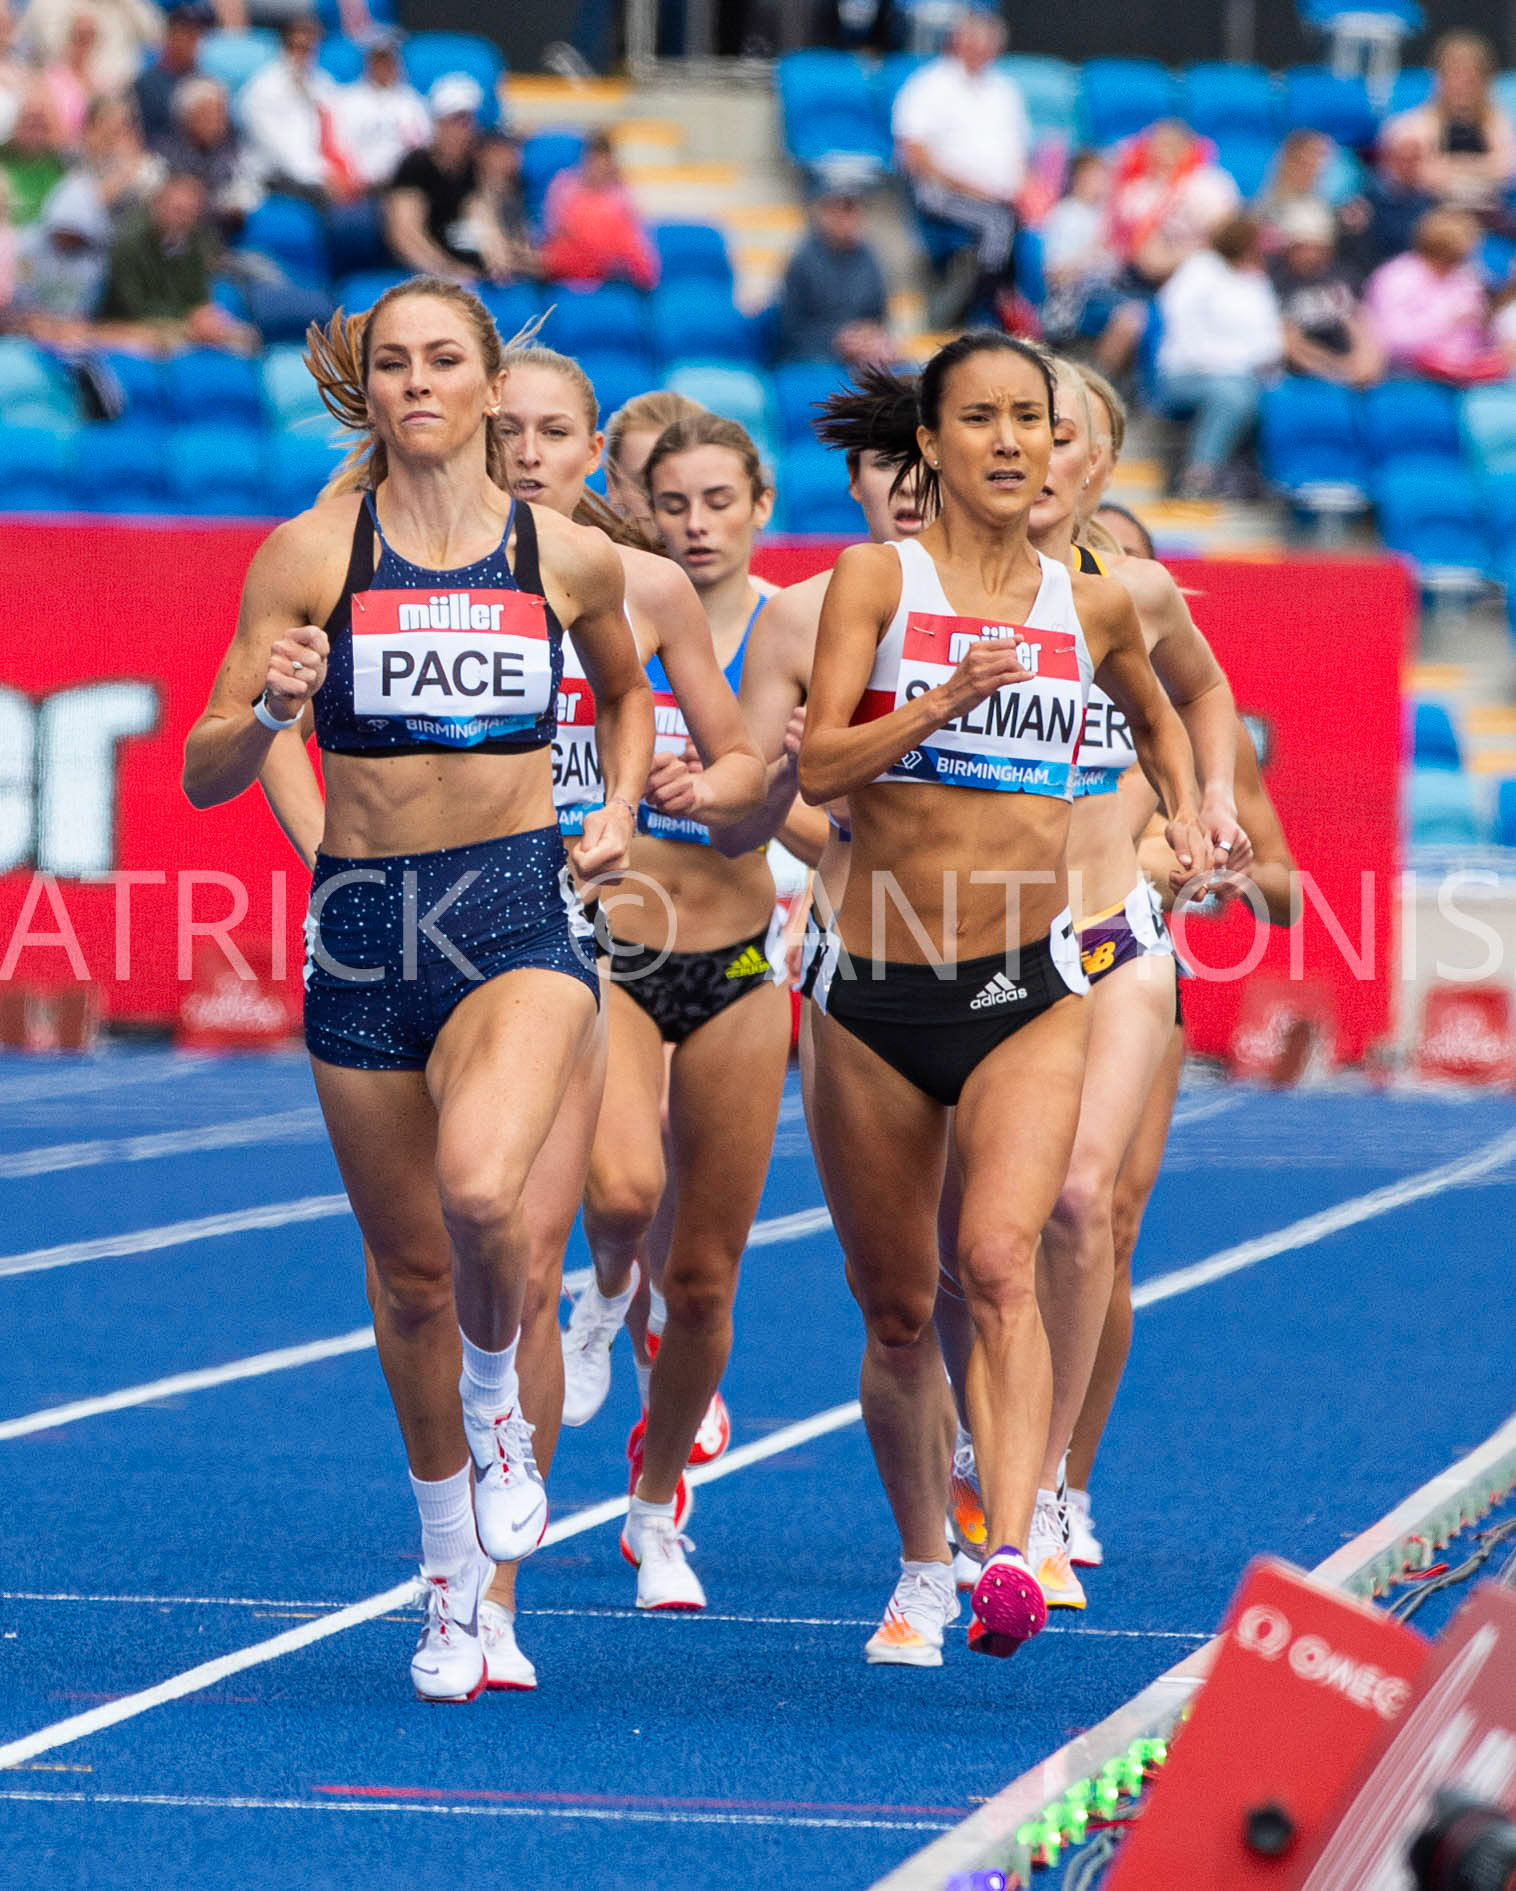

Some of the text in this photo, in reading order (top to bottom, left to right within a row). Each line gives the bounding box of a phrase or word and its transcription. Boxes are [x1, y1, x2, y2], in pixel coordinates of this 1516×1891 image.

[398, 592, 505, 632] müller
[948, 625, 1043, 673] mer
[381, 650, 525, 697] PACE
[1080, 702, 1134, 751] ER
[935, 755, 1050, 786] BIRMINGHAM
[969, 987, 1028, 1010] adidas
